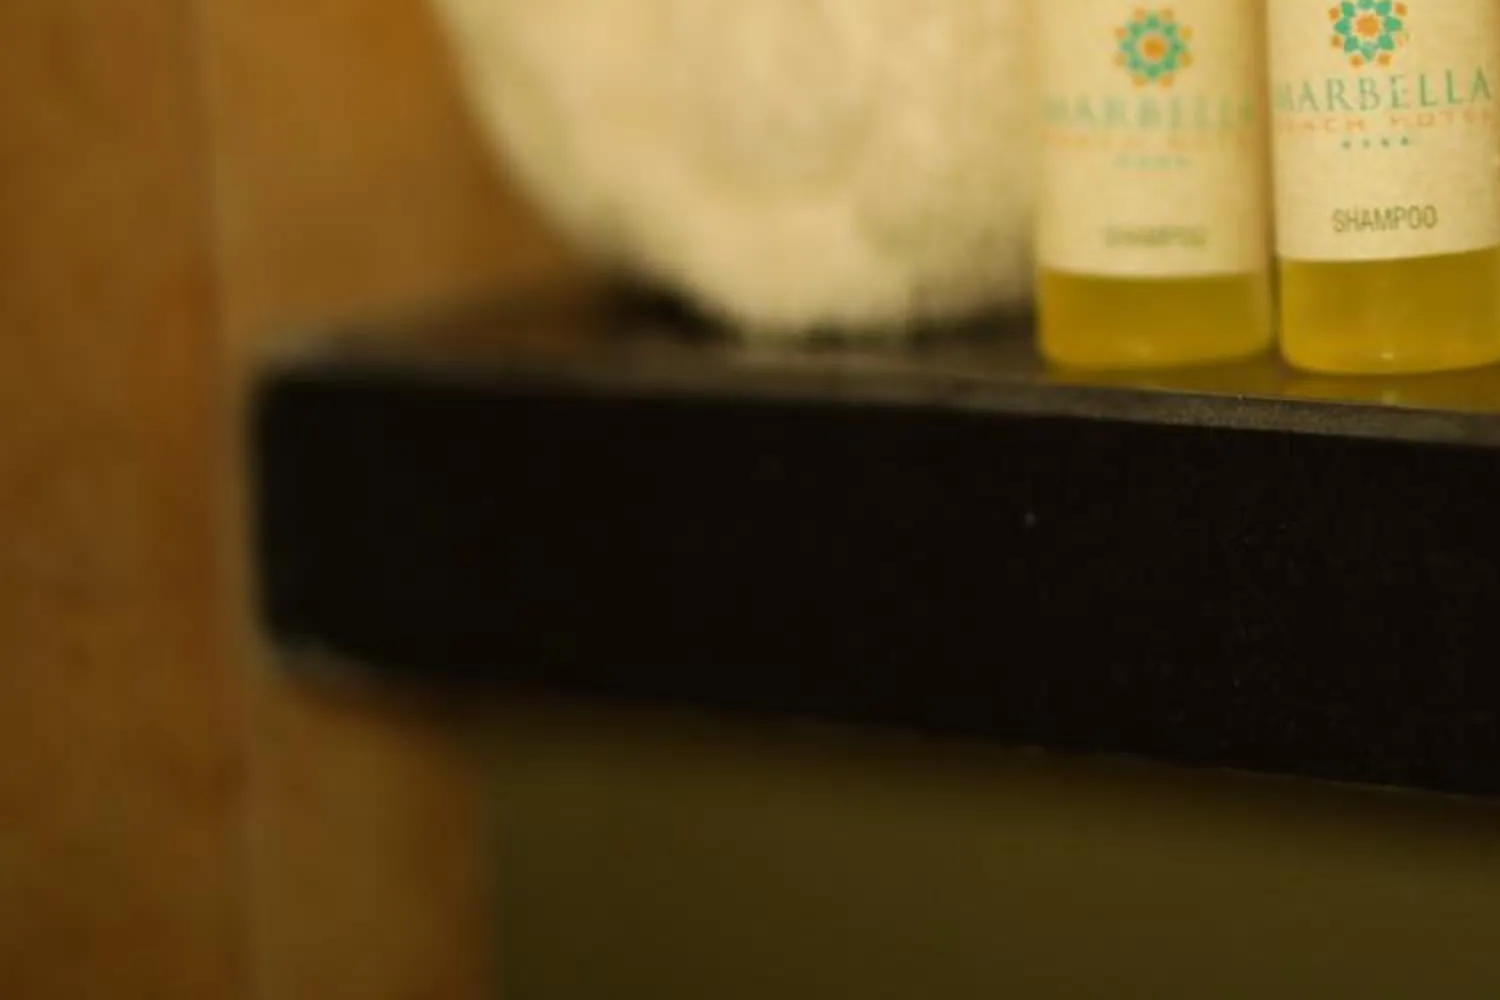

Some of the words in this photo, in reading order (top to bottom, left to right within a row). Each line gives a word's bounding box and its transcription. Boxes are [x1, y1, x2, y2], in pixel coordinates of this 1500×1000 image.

[1274, 66, 1493, 113] MARBELLA
[1276, 113, 1365, 134] ACH
[1331, 204, 1439, 233] SHAMPOO
